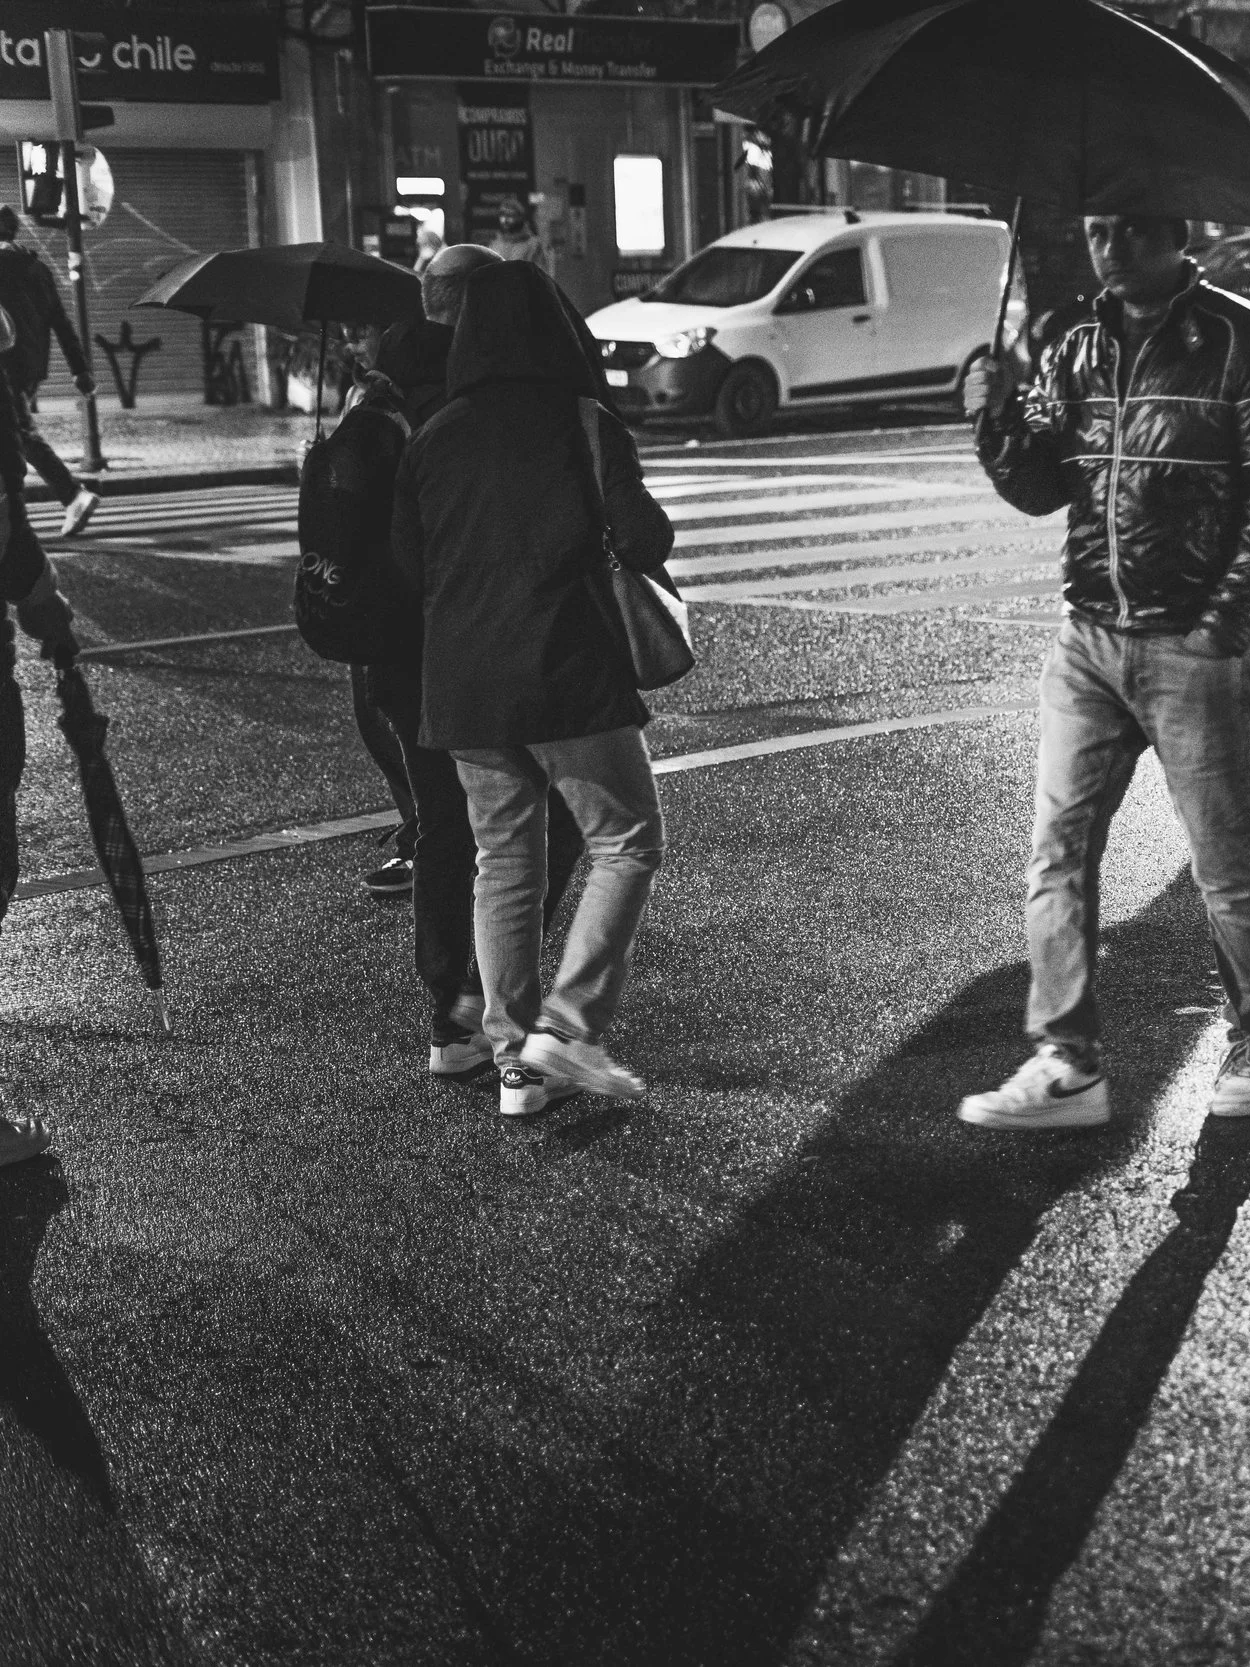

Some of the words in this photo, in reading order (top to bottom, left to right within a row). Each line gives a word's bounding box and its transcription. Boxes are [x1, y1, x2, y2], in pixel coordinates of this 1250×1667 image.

[112, 33, 196, 72] chile
[484, 59, 546, 81] Exchange
[561, 61, 604, 80] Money
[606, 60, 657, 78] Transfer
